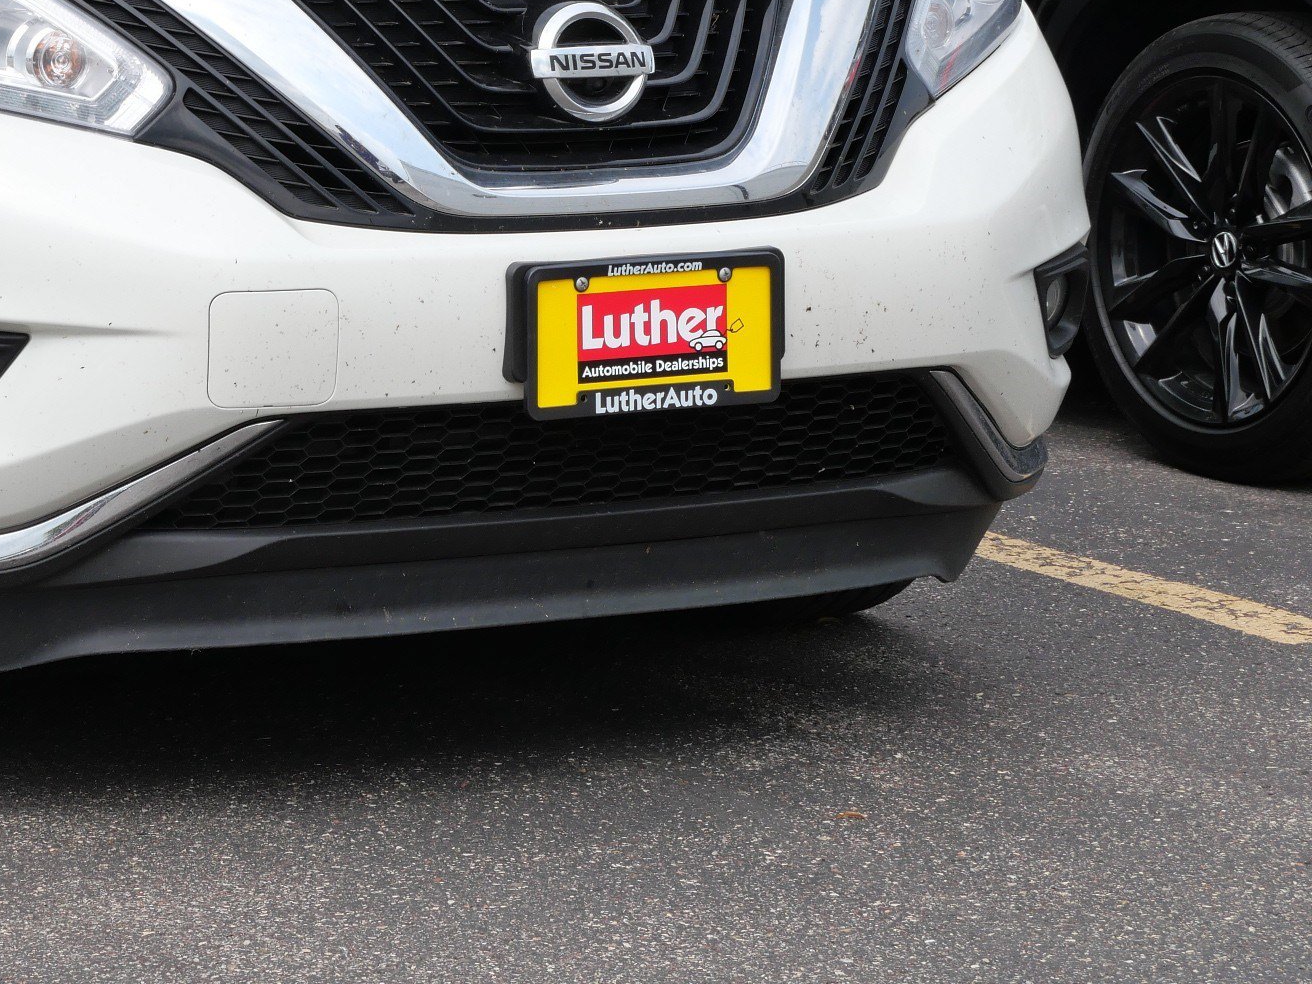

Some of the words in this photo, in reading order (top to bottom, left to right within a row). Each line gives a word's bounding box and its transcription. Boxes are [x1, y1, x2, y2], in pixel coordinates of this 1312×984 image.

[549, 51, 646, 72] NISSAN
[607, 260, 703, 277] LutherAuto.com
[581, 298, 724, 351] Luther
[581, 360, 653, 378] Automobile
[655, 355, 724, 373] Dealerships
[594, 385, 718, 415] LutherAuto
